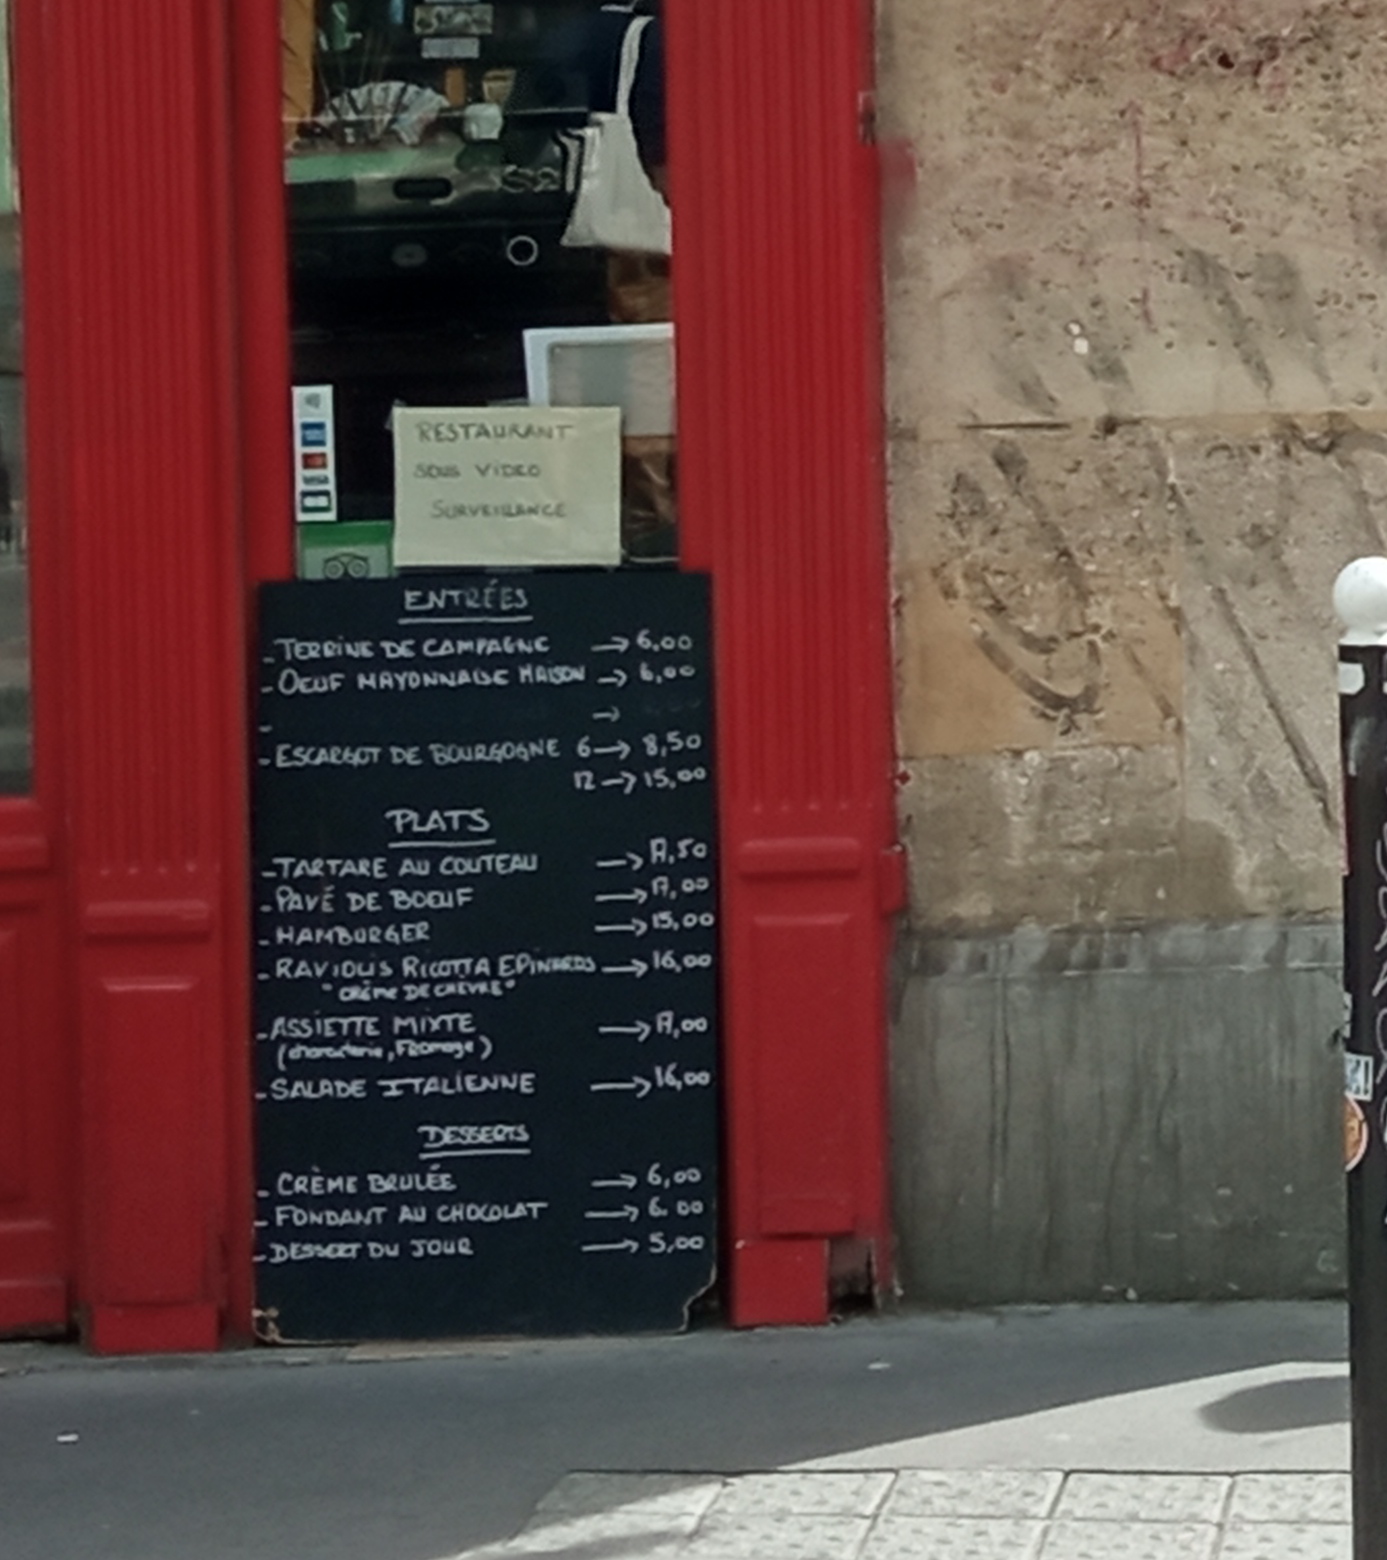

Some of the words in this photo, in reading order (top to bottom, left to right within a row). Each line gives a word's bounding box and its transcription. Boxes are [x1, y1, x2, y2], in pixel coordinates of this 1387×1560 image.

[414, 420, 575, 443] RESTAURANT
[413, 462, 462, 480] SOUS
[404, 578, 530, 611] ENTRÉES
[273, 636, 375, 661] TERRINE
[380, 640, 416, 659] DE
[422, 636, 551, 658] CAMPAGNE
[275, 742, 383, 768] ESCARGOT
[389, 745, 424, 766] DE
[428, 738, 561, 767] BOURGOGNE
[577, 735, 592, 758] 6
[642, 730, 703, 758] 8,50
[384, 807, 491, 834] PLATS
[272, 856, 389, 880] TARTARE
[398, 858, 431, 876] AU
[439, 852, 539, 875] COUTEAU
[275, 884, 336, 913] PAVÉ
[346, 891, 383, 912] DE
[275, 921, 431, 946] HAMBURGER
[275, 955, 394, 979] RAVIOLIS
[402, 955, 491, 979] RICOTTA
[402, 983, 431, 1001] DE
[269, 1012, 381, 1040] ASSIETTE
[392, 1010, 477, 1036] MIXTE
[269, 1077, 368, 1101] SALADE
[376, 1071, 537, 1096] ITALIENNE
[416, 1123, 531, 1148] DESSERTS
[276, 1164, 359, 1196] CRÈME
[366, 1162, 458, 1193] BRULÉE
[274, 1204, 389, 1227] FONDANT
[398, 1204, 428, 1223] AU
[436, 1200, 549, 1223] CHOCOLAT
[268, 1242, 363, 1264] DESSERT
[366, 1240, 401, 1259] DU
[408, 1236, 475, 1258] JOUR
